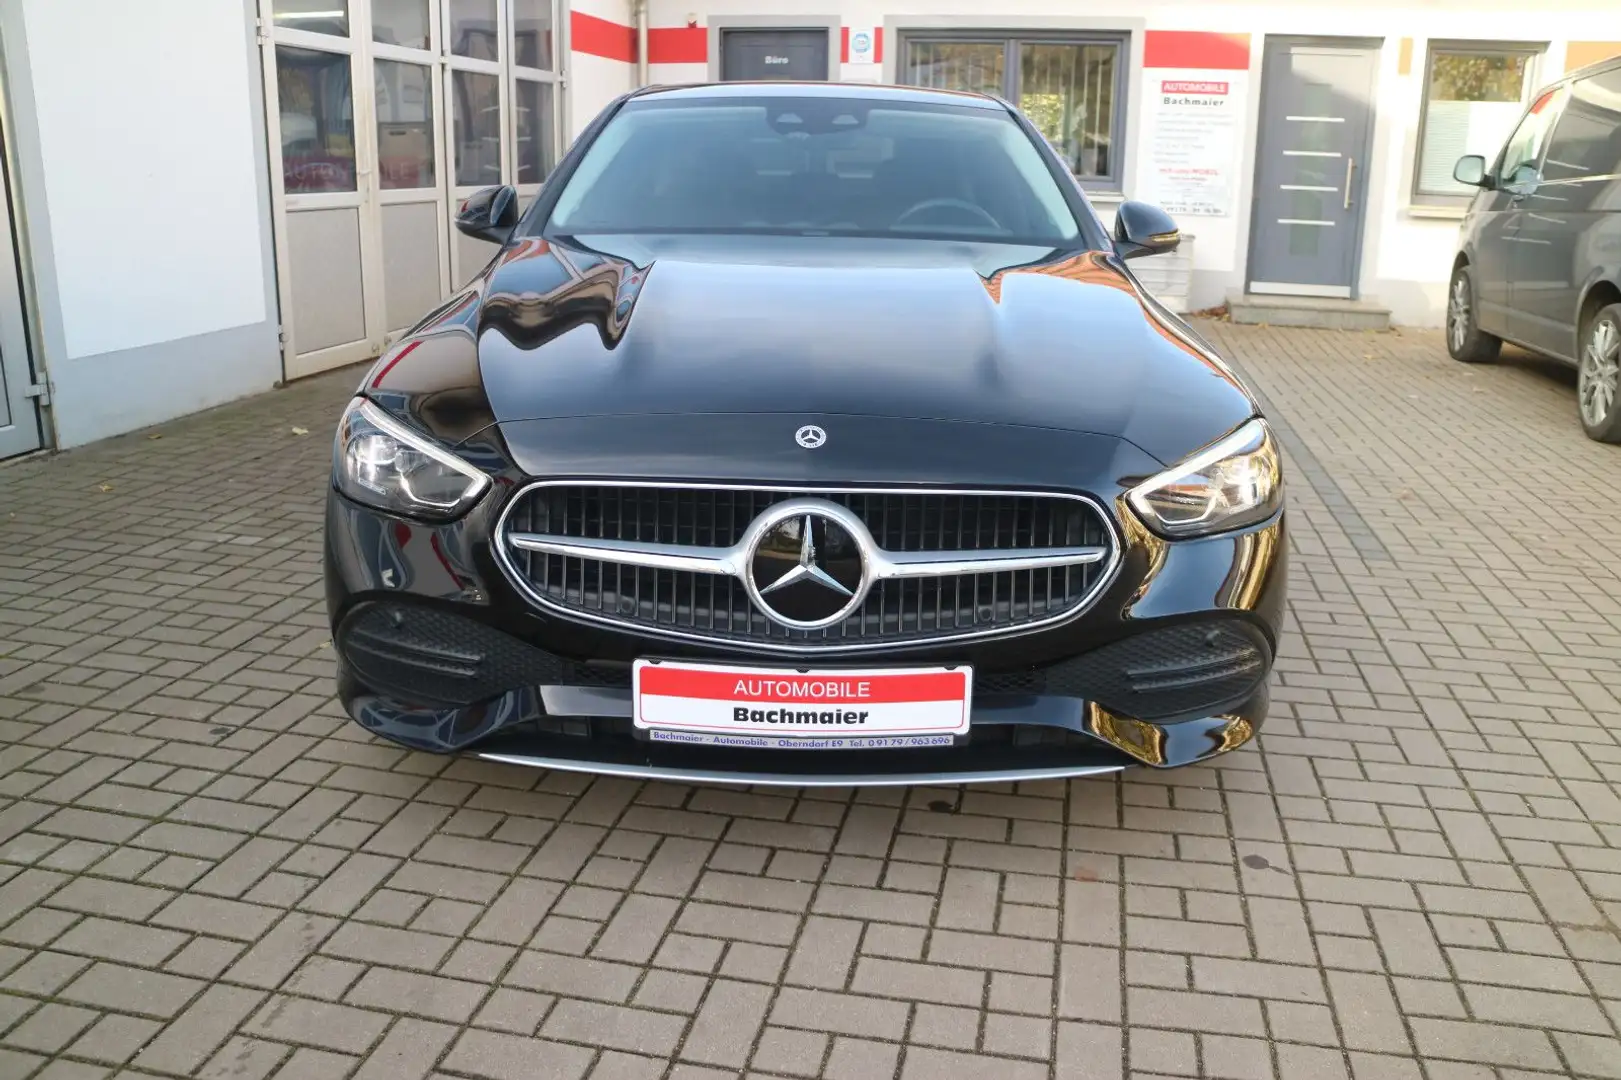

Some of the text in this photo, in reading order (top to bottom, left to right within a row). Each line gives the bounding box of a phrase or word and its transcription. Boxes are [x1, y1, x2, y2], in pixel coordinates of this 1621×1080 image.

[764, 55, 789, 65] Büro
[1163, 83, 1225, 93] AUTOMOBILE
[1163, 97, 1224, 107] Bachmaier
[733, 679, 870, 698] AUTOMOBILE
[733, 707, 869, 725] Bachmaier
[653, 731, 703, 743] Bachmaier
[713, 736, 768, 747] Automobile
[778, 739, 829, 748] Oberndorf
[831, 739, 844, 748] E9
[849, 739, 865, 748] Tel.
